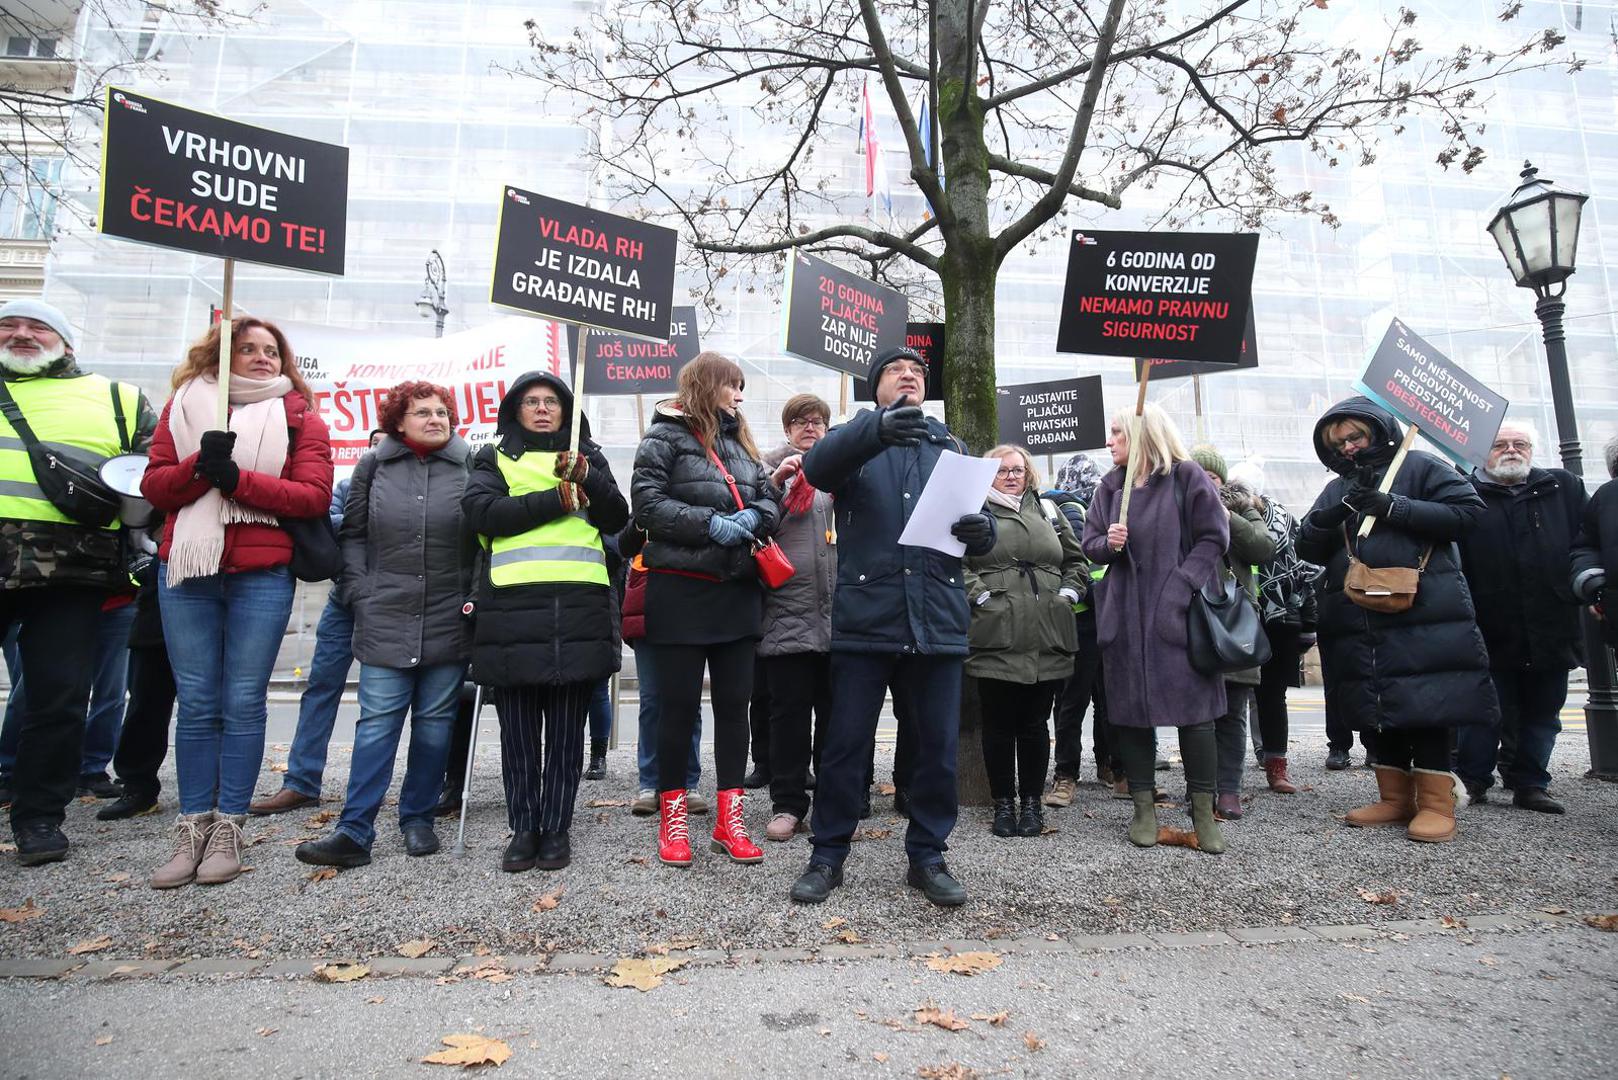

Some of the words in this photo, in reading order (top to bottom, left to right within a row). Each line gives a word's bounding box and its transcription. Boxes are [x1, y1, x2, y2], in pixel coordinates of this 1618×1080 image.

[161, 125, 305, 183] VRHOVNI
[191, 170, 278, 212] SUDE
[130, 185, 271, 244] ČEKAMO
[281, 222, 325, 254] TE!
[539, 217, 608, 252] VLADA
[616, 237, 644, 261] RH
[534, 248, 561, 271] JE
[568, 254, 641, 289] IZDALA
[1106, 251, 1116, 268] 6
[1121, 251, 1186, 270] GODINA
[1190, 253, 1216, 271] OD
[512, 272, 615, 313] GRAĐANE
[622, 298, 657, 322] RH!
[818, 275, 834, 295] 20
[837, 283, 884, 315] GODINA
[1104, 274, 1210, 295] KONVERZIJE
[821, 296, 879, 334] PLJAČKE,
[1080, 296, 1153, 316] NEMAMO
[1158, 299, 1230, 319] PRAVNU
[821, 315, 846, 338] ZAR
[850, 325, 877, 350] NIJE
[906, 334, 932, 347] DINA
[1101, 320, 1200, 342] SIGURNOST
[296, 356, 319, 370] UGA
[596, 340, 624, 358] JOŠ
[627, 343, 678, 358] UVIJEK
[824, 335, 872, 366] DOSTA?
[606, 363, 671, 380] ČEKAMO!
[1396, 338, 1427, 366] SAMO
[1427, 360, 1494, 413] NIŠTETNOST
[1019, 389, 1078, 406] ZAUSTAVITE
[1393, 368, 1471, 432] PREDSTAVLJA
[1411, 366, 1463, 411] UGOVORA
[1022, 416, 1079, 432] HRVATSKIH
[1027, 403, 1073, 418] PLJAČKU
[1026, 431, 1077, 446] GRAĐANA
